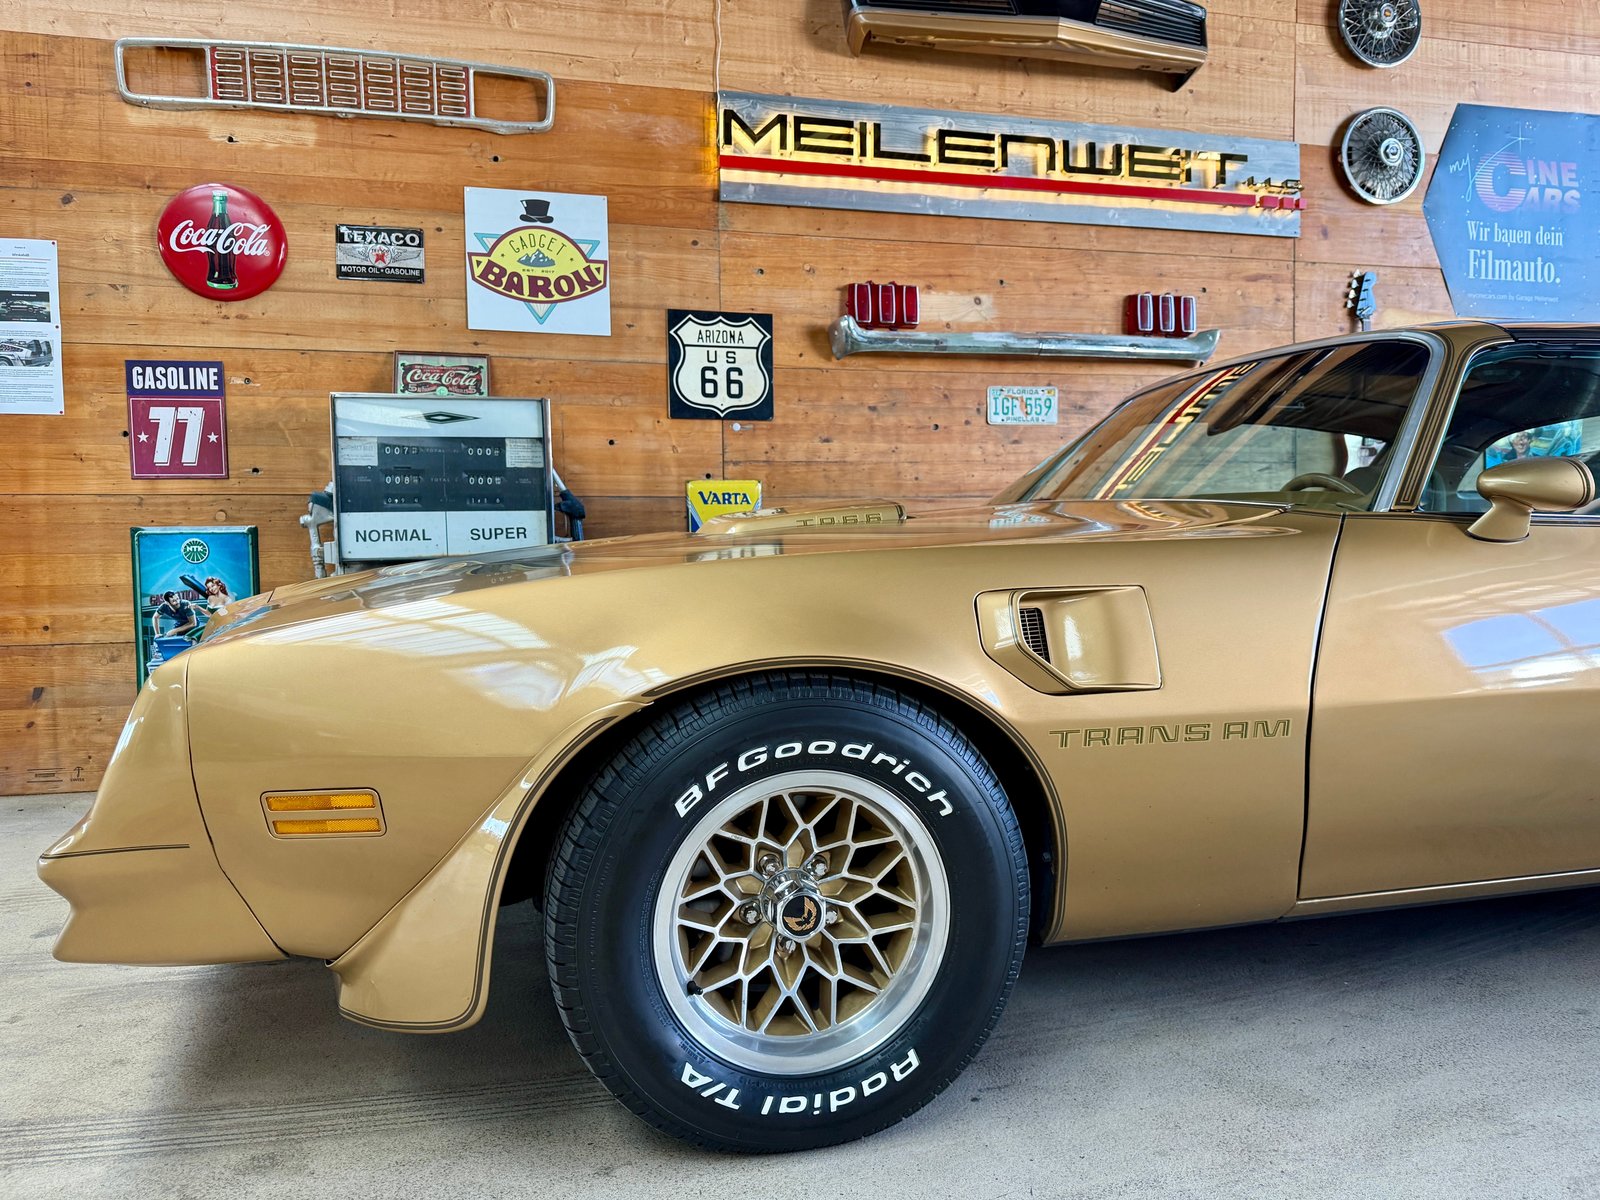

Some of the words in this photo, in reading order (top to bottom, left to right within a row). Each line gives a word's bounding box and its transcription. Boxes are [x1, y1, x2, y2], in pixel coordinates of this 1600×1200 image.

[723, 107, 1248, 186] MEILENWEIT
[169, 219, 271, 256] Coca-Cola
[340, 229, 420, 247] TEXACO
[508, 233, 567, 256] GADGET
[1467, 220, 1490, 241] Wir
[1494, 222, 1531, 246] bauen
[1535, 225, 1563, 246] dein
[341, 265, 367, 274] MOTOR
[368, 266, 380, 274] OIL
[385, 267, 420, 277] GASOLINE
[477, 258, 602, 299] BARON
[1467, 248, 1561, 284] Filmauto.
[697, 329, 745, 344] ARIZONA
[132, 366, 219, 391] GASOLINE
[406, 368, 479, 386] Coca-Cola
[701, 366, 743, 399] 66
[148, 406, 205, 466] 77
[698, 490, 752, 505] VARTA
[355, 528, 432, 543] NORMAL
[470, 526, 527, 541] SUPER
[1049, 723, 1211, 748] TRANS
[1222, 719, 1290, 741] AM
[680, 1062, 742, 1110] T/A
[761, 1048, 920, 1115] Radial
